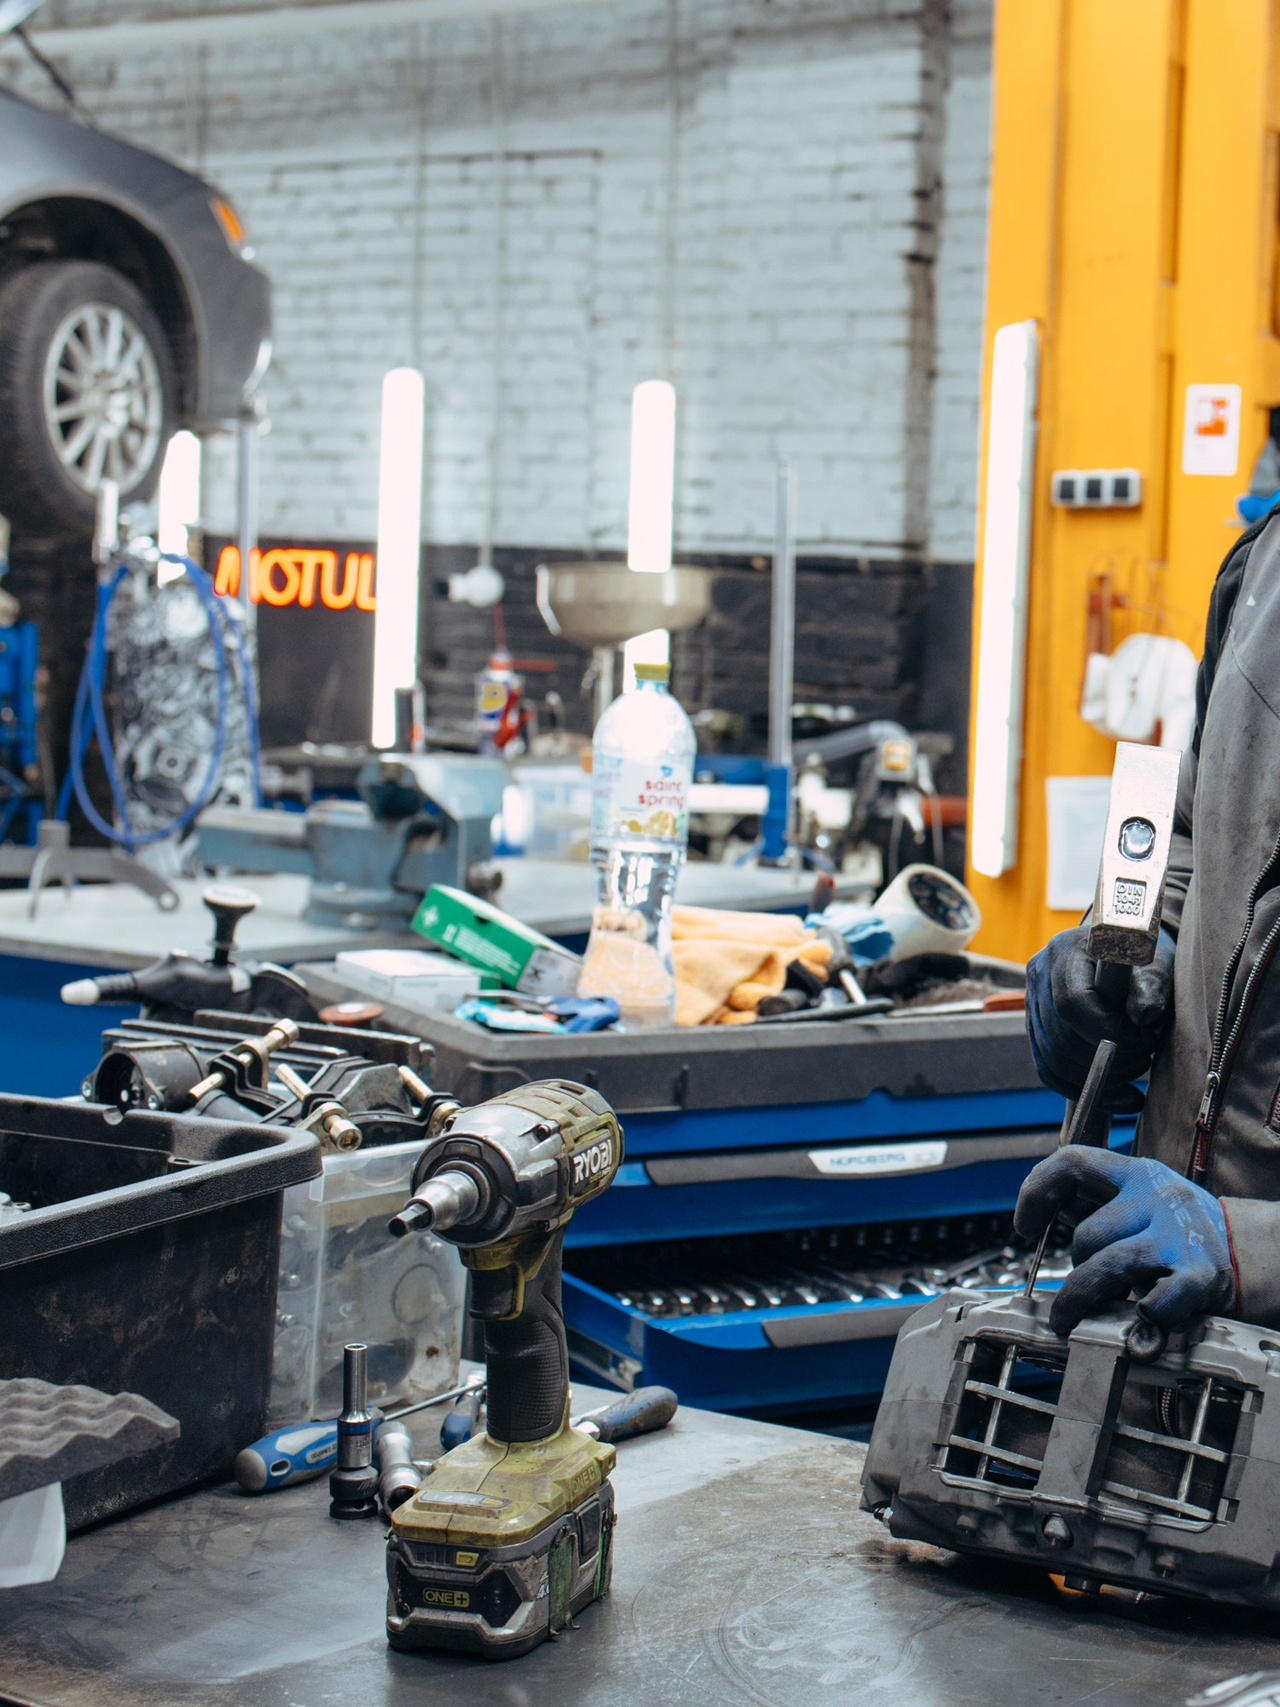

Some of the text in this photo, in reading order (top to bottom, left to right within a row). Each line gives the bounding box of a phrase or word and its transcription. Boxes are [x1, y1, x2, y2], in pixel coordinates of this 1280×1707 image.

[213, 545, 378, 611] MOTUL
[1116, 884, 1144, 897] DIN
[1116, 894, 1142, 907] 1041
[1114, 904, 1141, 917] 1000
[573, 1139, 613, 1184] RYOBI
